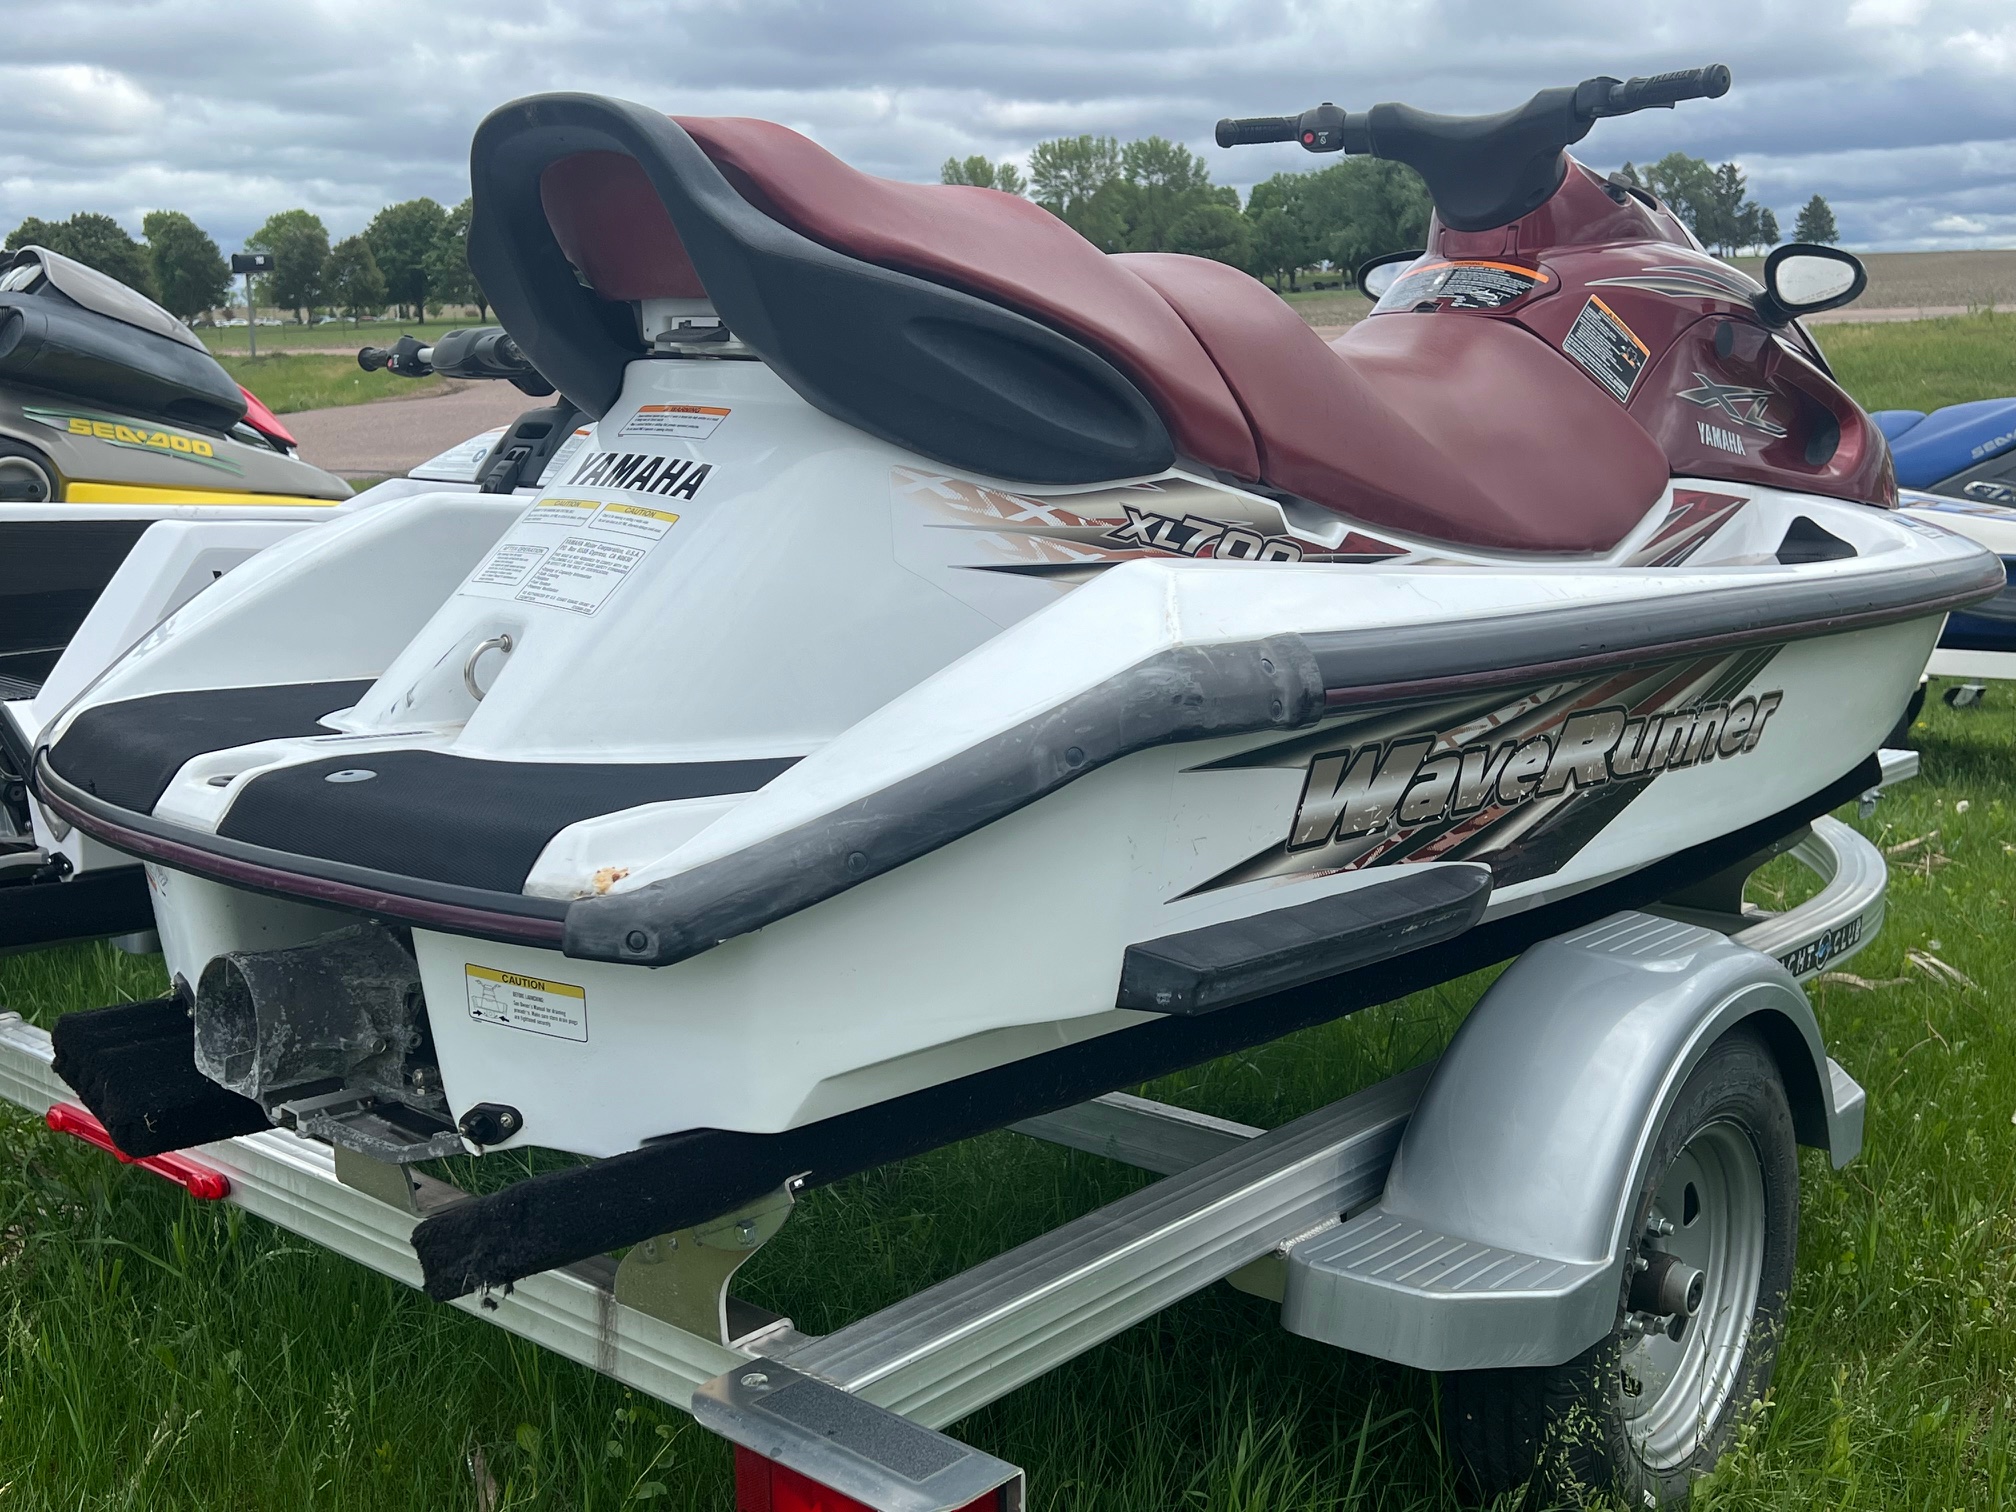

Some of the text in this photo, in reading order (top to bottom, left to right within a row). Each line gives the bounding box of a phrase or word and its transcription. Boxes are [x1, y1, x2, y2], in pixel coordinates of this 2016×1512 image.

[1676, 371, 1788, 439] XL
[1696, 420, 1747, 457] YAMAHA
[566, 452, 713, 501] YAMAHA
[553, 499, 581, 508] CAUTION
[624, 506, 657, 519] CAUTION
[1102, 504, 1303, 562] XL700
[1287, 690, 1784, 853] WaveRunner
[1781, 914, 1863, 975] CHT CLUB
[501, 974, 546, 991] CAUTION
